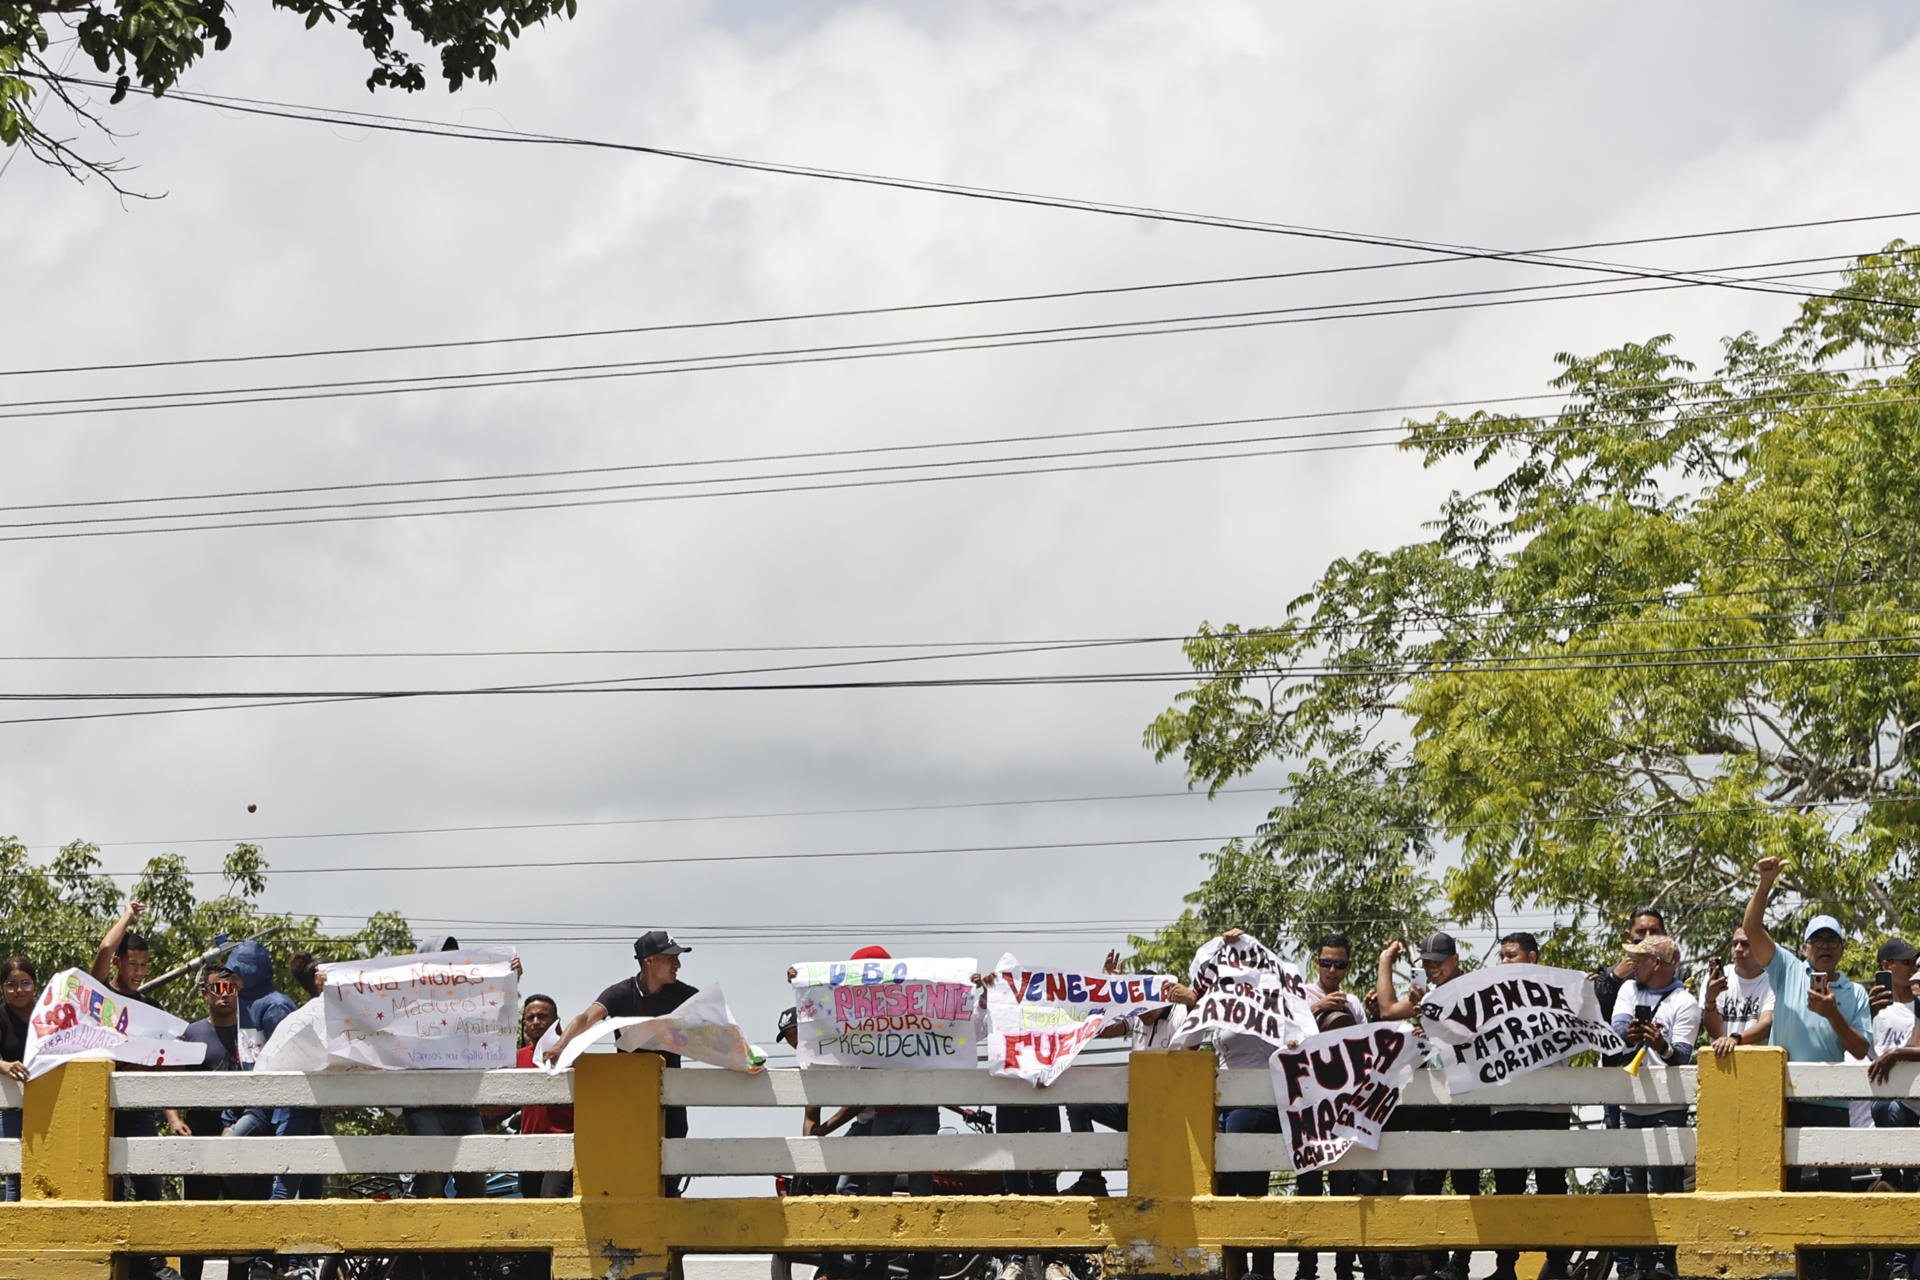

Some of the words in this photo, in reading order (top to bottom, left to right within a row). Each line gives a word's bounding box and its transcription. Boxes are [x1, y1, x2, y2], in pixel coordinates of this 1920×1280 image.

[410, 962, 485, 989] Nicolas
[1002, 971, 1173, 1004] VENEZUELA
[834, 982, 973, 1023] PRESENTE
[1445, 979, 1576, 1034] VENDE
[842, 1013, 933, 1037] MADURO
